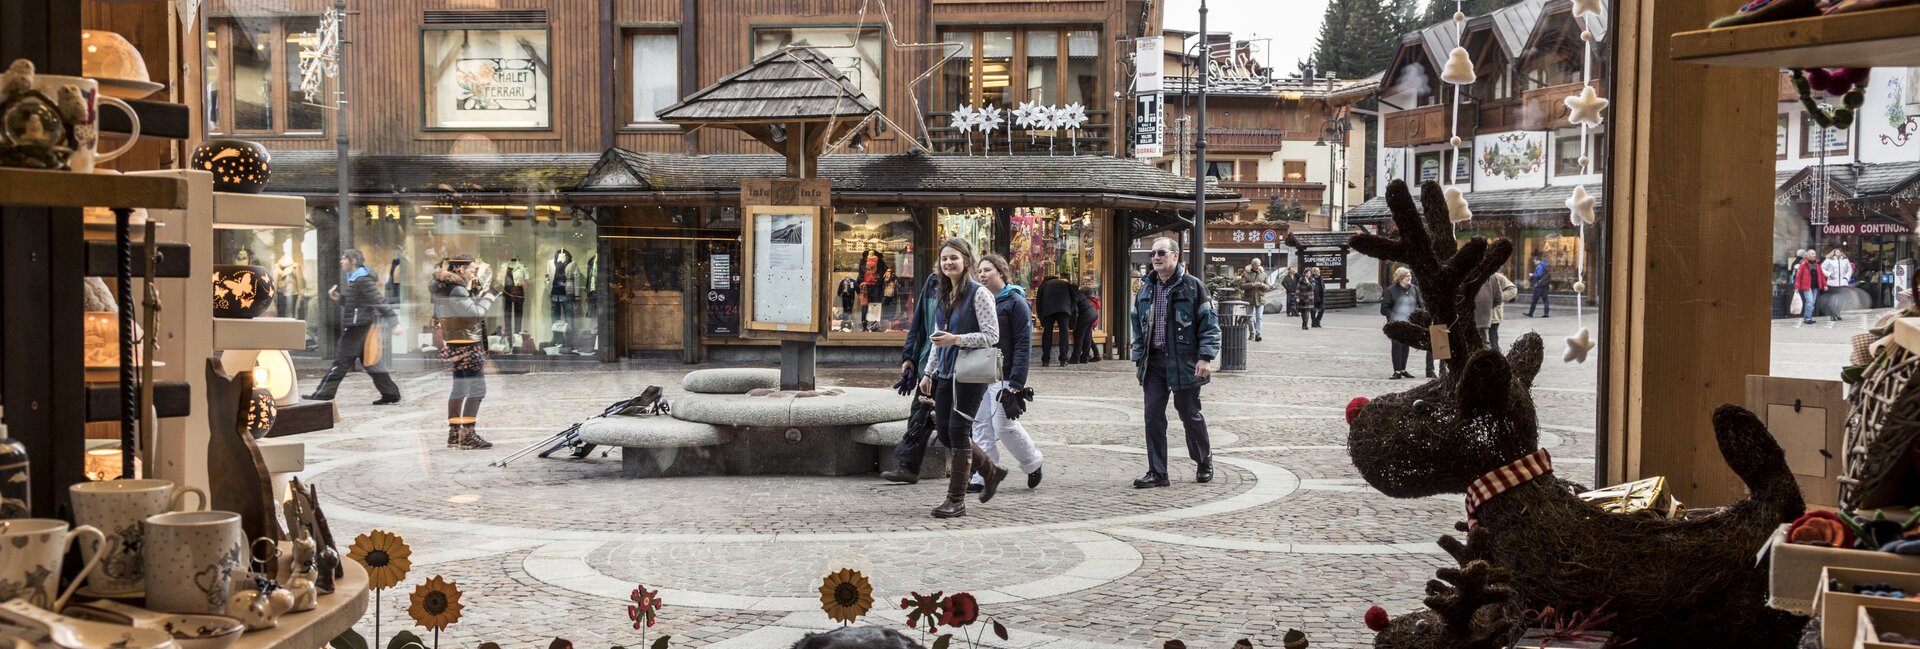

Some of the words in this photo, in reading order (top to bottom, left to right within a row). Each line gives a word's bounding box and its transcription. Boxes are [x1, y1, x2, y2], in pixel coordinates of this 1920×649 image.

[493, 72, 528, 83] CHALET
[485, 87, 525, 97] FERRARI
[1823, 224, 1855, 234] ORARIO
